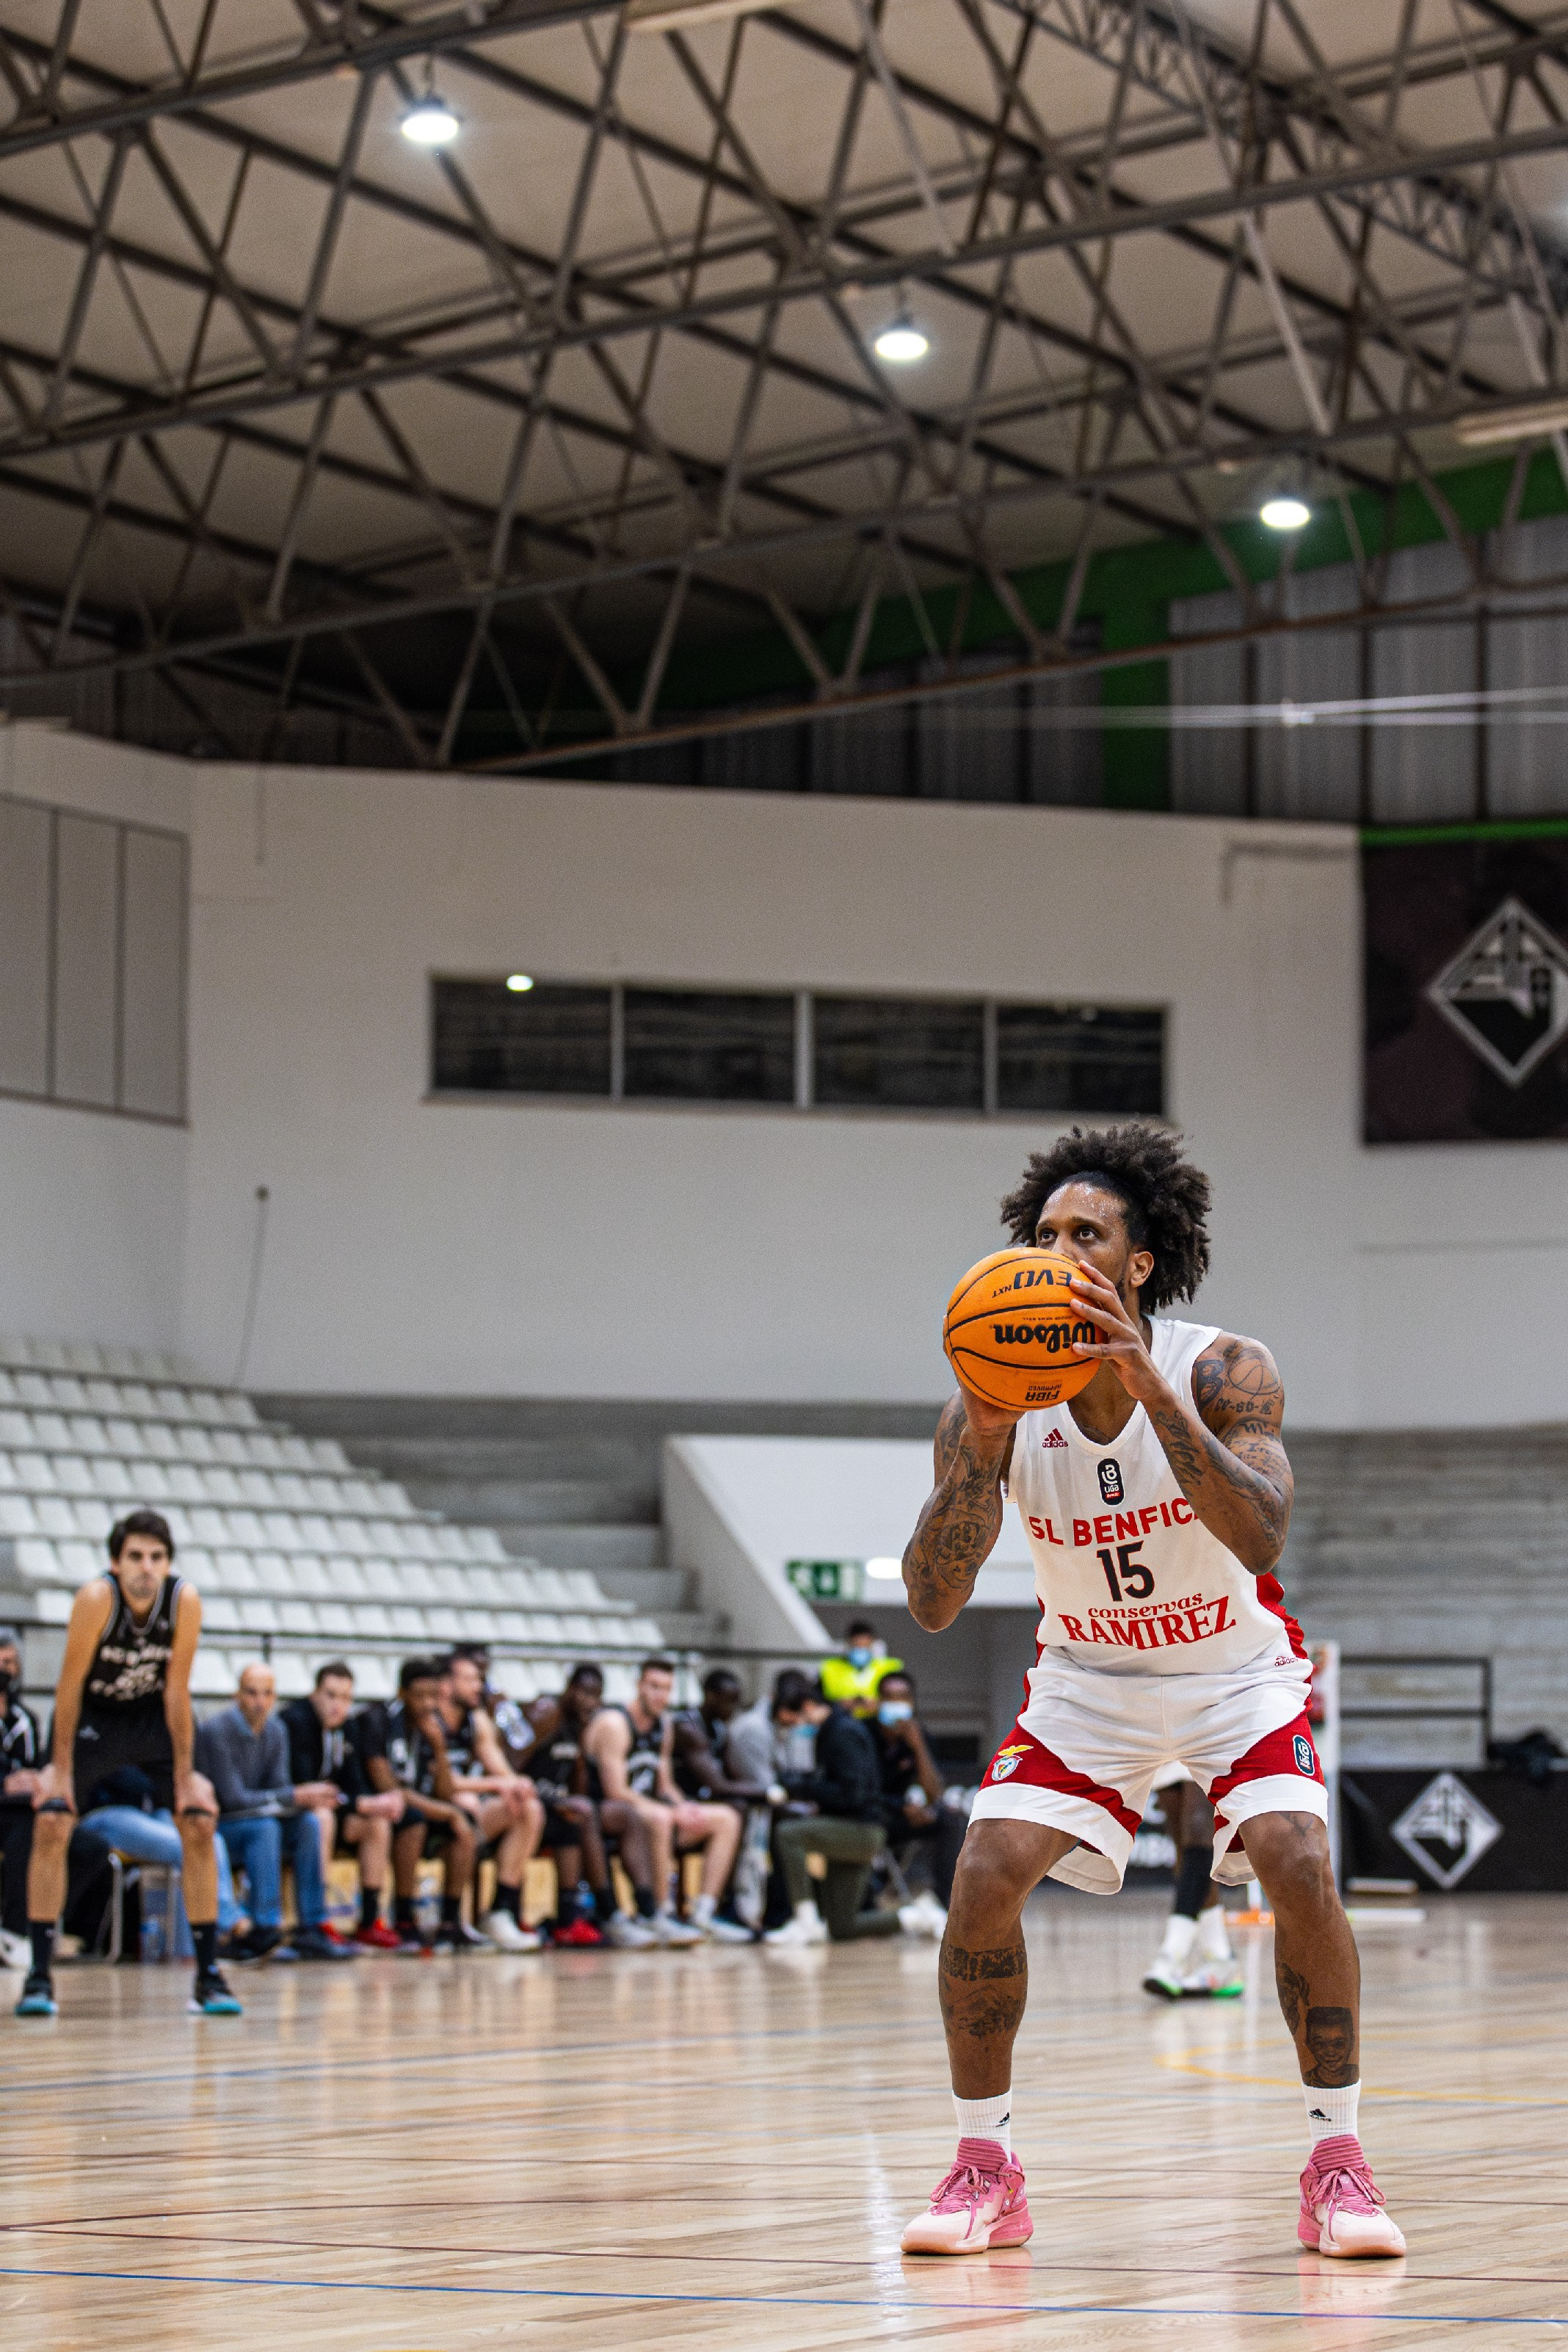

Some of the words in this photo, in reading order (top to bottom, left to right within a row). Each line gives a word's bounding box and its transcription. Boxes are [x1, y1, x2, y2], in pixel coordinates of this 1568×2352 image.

[1013, 1269, 1072, 1290] EVO
[992, 1285, 1012, 1298] NXT
[993, 1321, 1096, 1354] Wilson
[1025, 1390, 1060, 1402] FIBA
[1028, 1383, 1061, 1391] APPROVED
[1042, 1439, 1068, 1448] adidas
[1028, 1516, 1064, 1546] SL
[1072, 1498, 1199, 1547] BENFIC
[1097, 1540, 1155, 1602] 15
[1088, 1593, 1203, 1619] conservas
[1058, 1595, 1236, 1650] RAMIREZ
[1274, 1657, 1299, 1667] adidas
